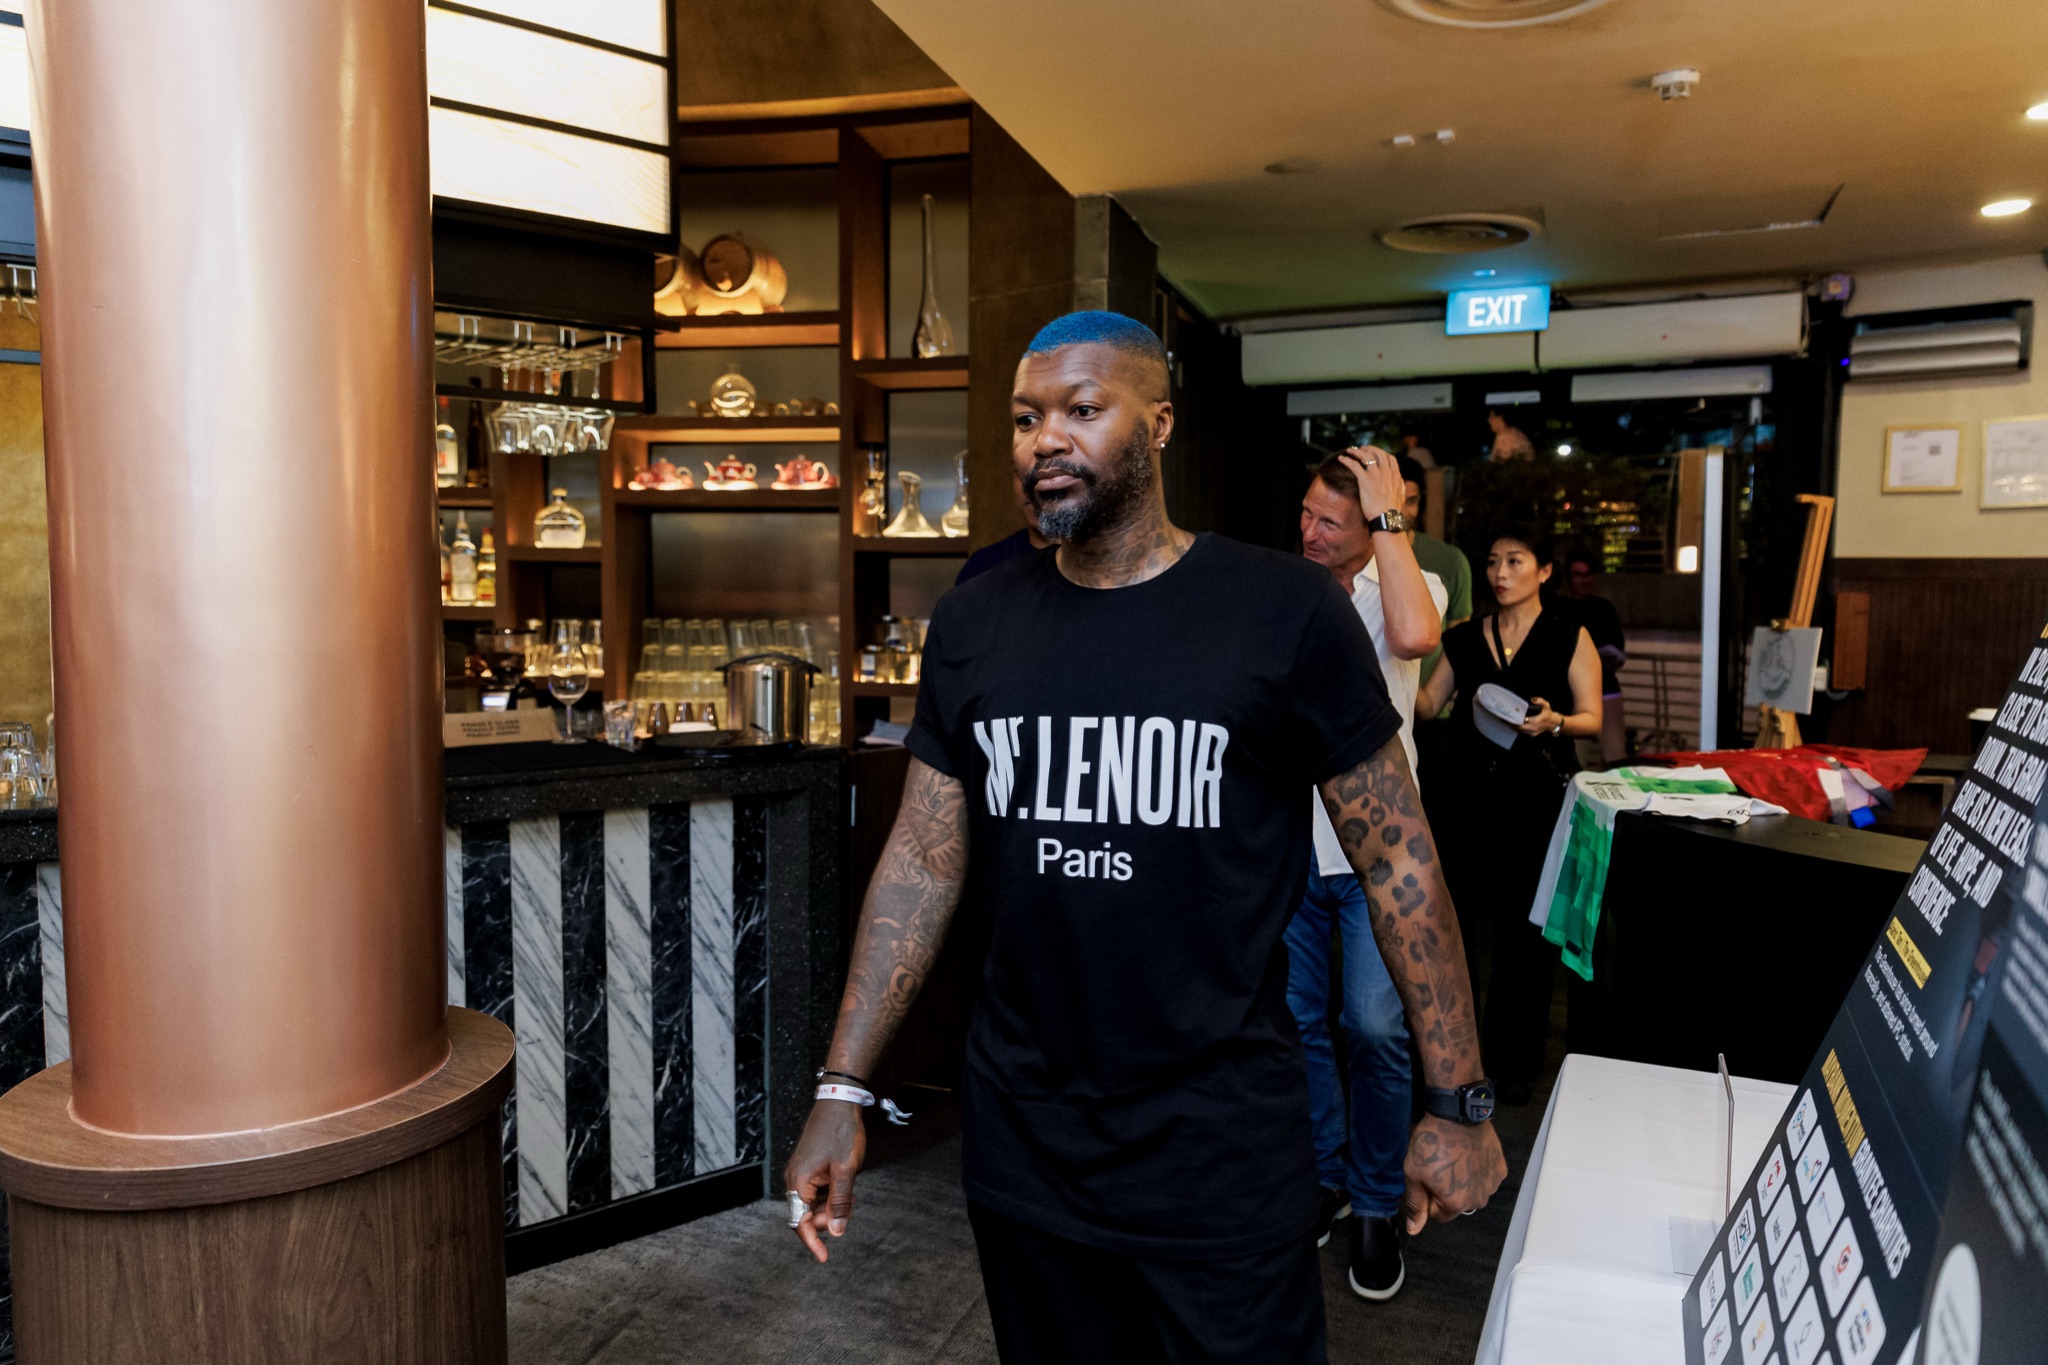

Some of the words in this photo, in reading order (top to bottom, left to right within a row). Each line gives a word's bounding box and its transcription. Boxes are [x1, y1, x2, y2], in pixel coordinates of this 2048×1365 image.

[1468, 294, 1527, 327] EXIT
[1996, 691, 2033, 733] CLOSE
[2018, 698, 2043, 737] TO
[1995, 746, 2028, 790] THIS
[1951, 779, 1982, 821] GAVE
[1967, 789, 1991, 829] US
[1975, 796, 1997, 834] A
[1930, 821, 1952, 857] OF
[1981, 800, 2016, 847] NEW
[1037, 838, 1133, 881] Paris
[1937, 828, 1965, 878] LIFE,
[1951, 841, 1985, 899] HOPE,
[1908, 864, 1956, 936] CONFIDENCE.
[1970, 860, 2003, 909] AND
[1918, 1027, 1940, 1059] around
[1851, 1137, 1885, 1211] GRANTEE
[1869, 1186, 1911, 1280] CHARITIES
